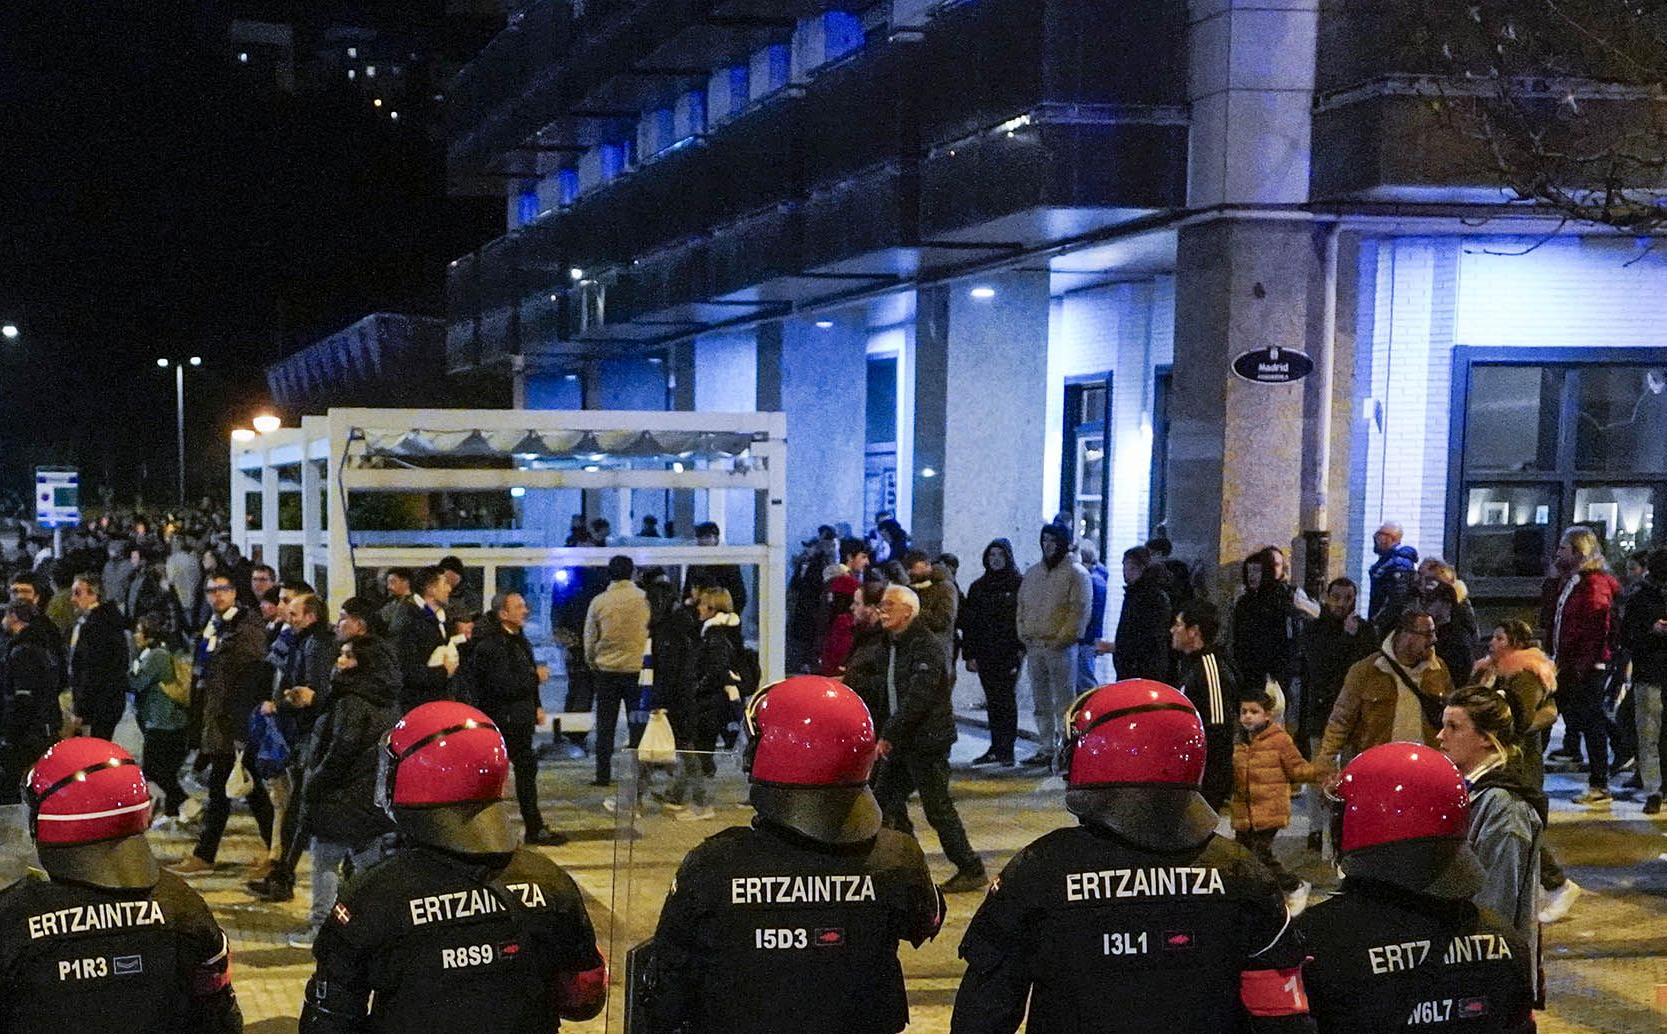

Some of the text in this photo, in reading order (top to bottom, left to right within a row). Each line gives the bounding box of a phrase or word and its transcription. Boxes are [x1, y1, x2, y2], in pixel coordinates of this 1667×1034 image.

[1258, 362, 1289, 372] Madrid
[731, 875, 876, 904] ERTZAINTZA
[1066, 867, 1226, 901] ERTZAINTZA
[28, 900, 165, 939] ERTZAINTZA
[755, 928, 808, 949] I5D3
[442, 944, 494, 969] R8S9
[1368, 934, 1512, 975] ERTZINTZA
[58, 957, 108, 981] P1R3
